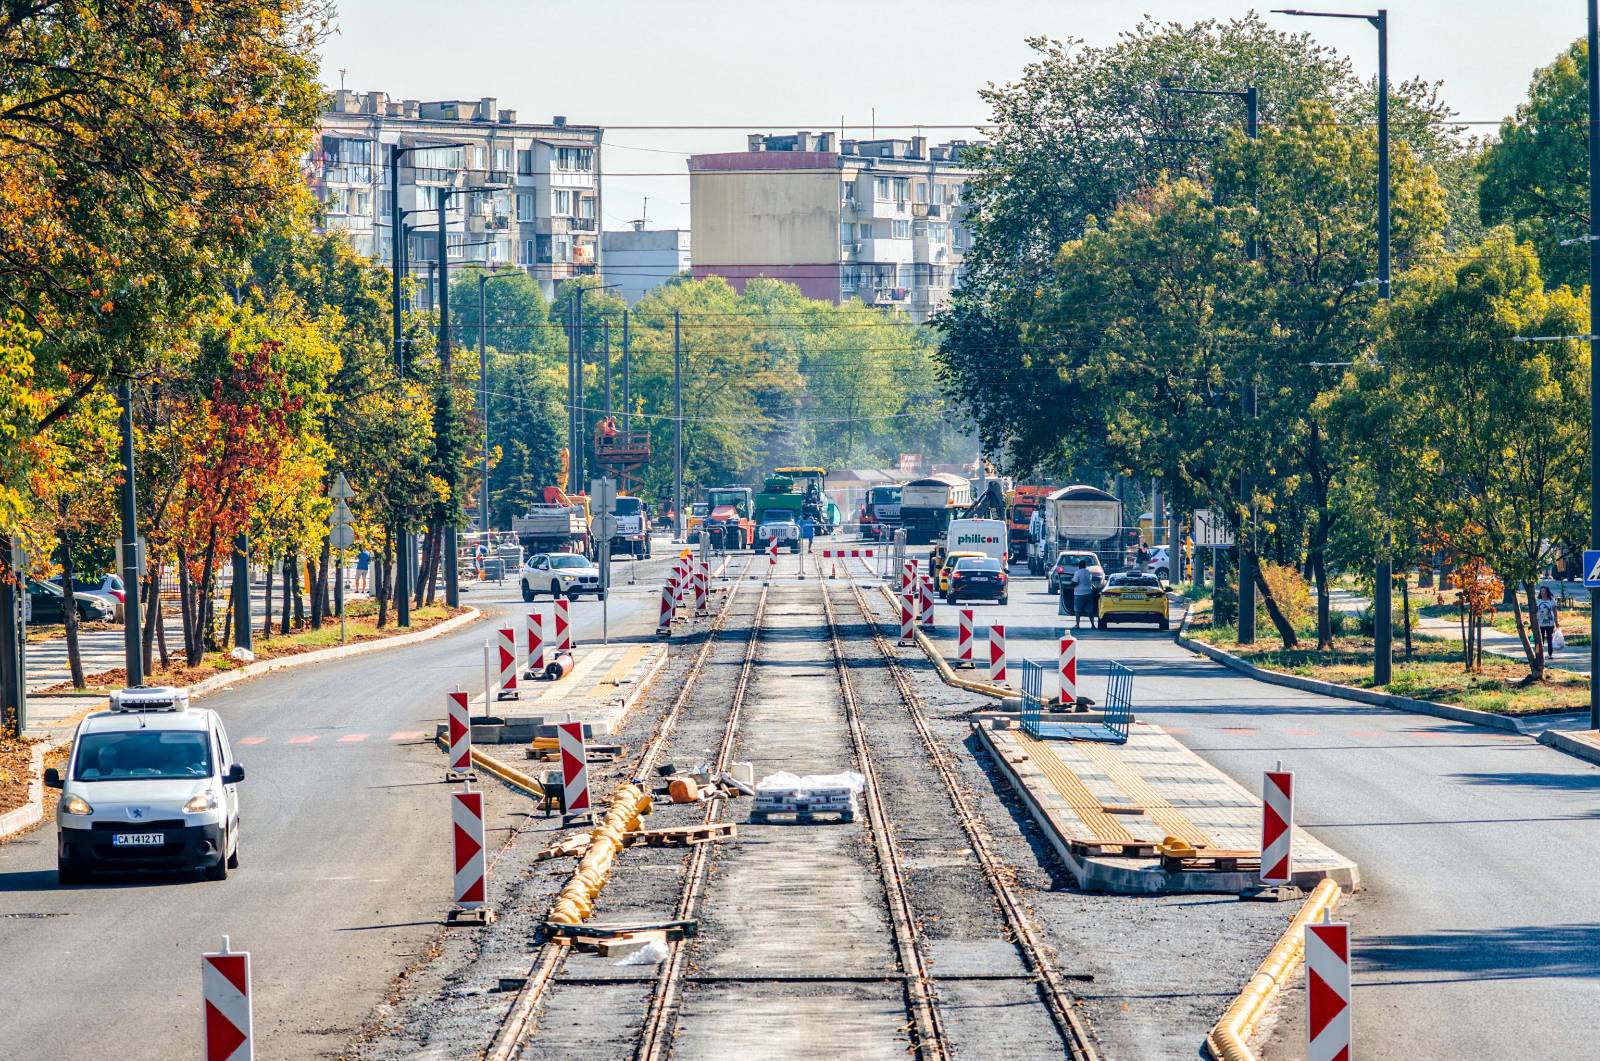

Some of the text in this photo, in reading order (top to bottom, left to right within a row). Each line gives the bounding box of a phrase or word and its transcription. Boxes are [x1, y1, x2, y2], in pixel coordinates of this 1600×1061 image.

[958, 534, 999, 545] philicon
[118, 834, 162, 844] CA 1412 XT
